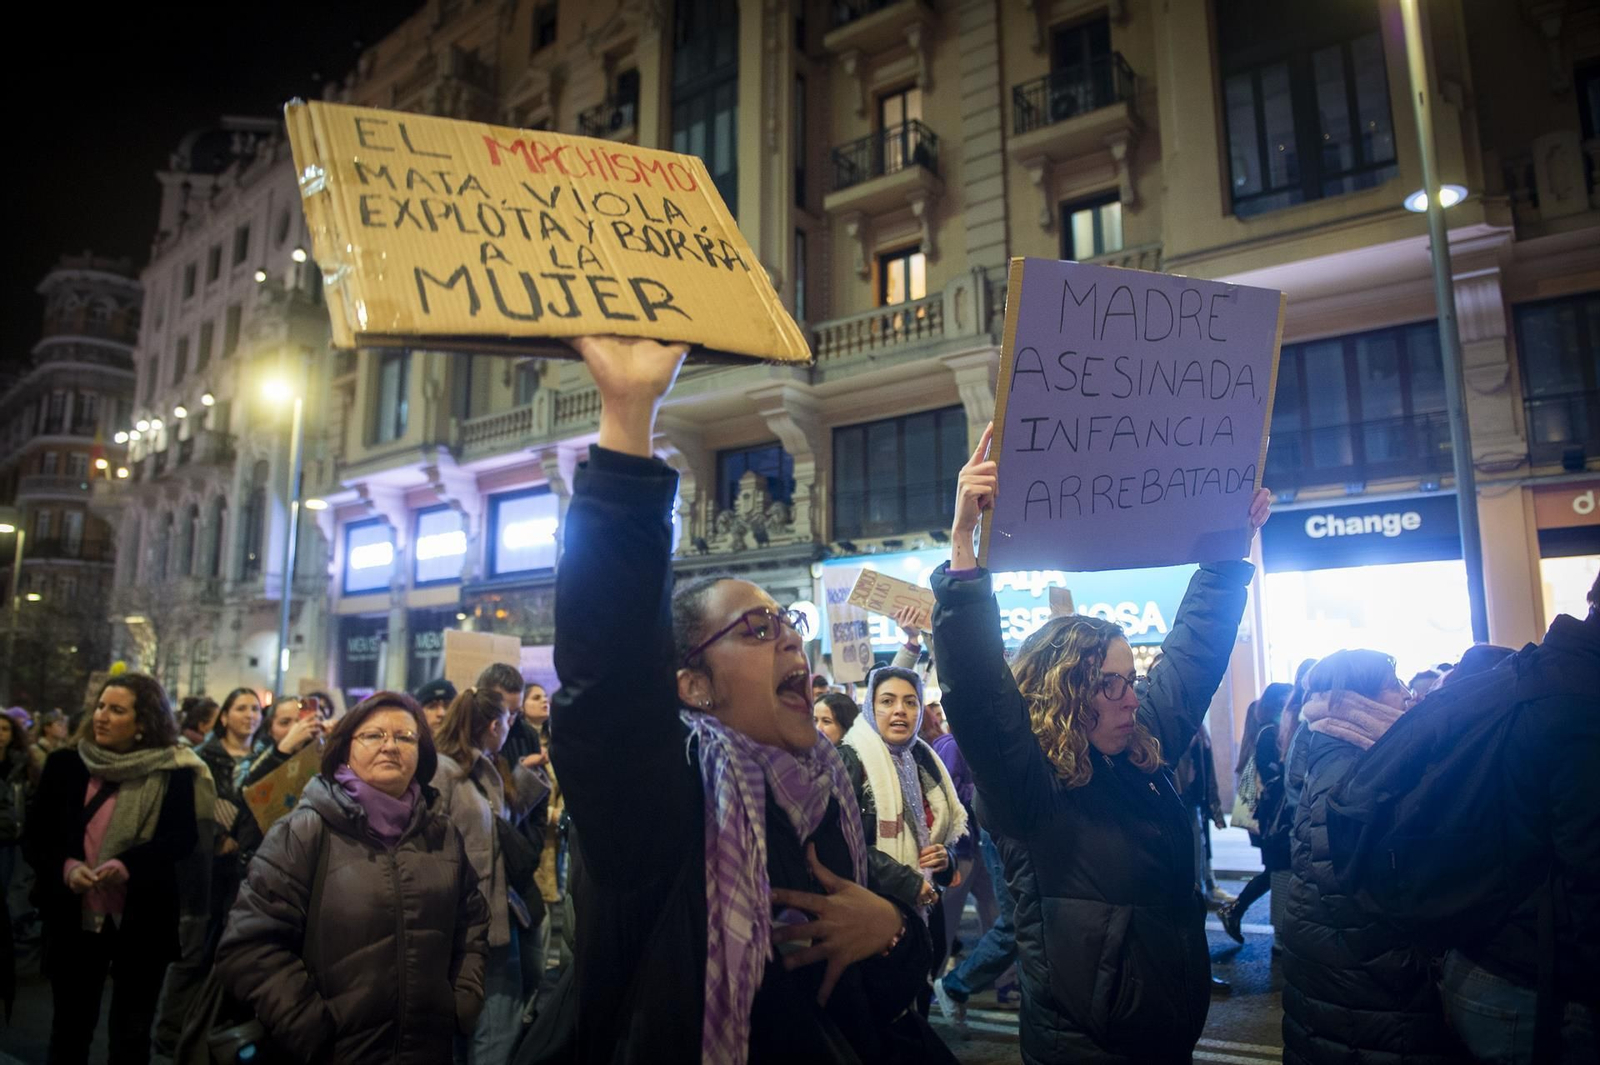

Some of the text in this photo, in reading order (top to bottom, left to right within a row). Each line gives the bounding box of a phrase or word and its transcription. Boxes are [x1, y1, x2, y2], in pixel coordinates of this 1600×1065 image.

[354, 117, 452, 160] EL
[359, 194, 750, 272] EXPLOTA Y BORRA
[480, 241, 604, 271] A LA
[414, 265, 693, 322] MUJER
[1060, 279, 1230, 342] MADRE
[1010, 346, 1262, 405] ASESINADA,
[1016, 415, 1234, 452] INFANCIA
[1024, 464, 1257, 522] ARREBATADA
[1305, 511, 1421, 538] Change
